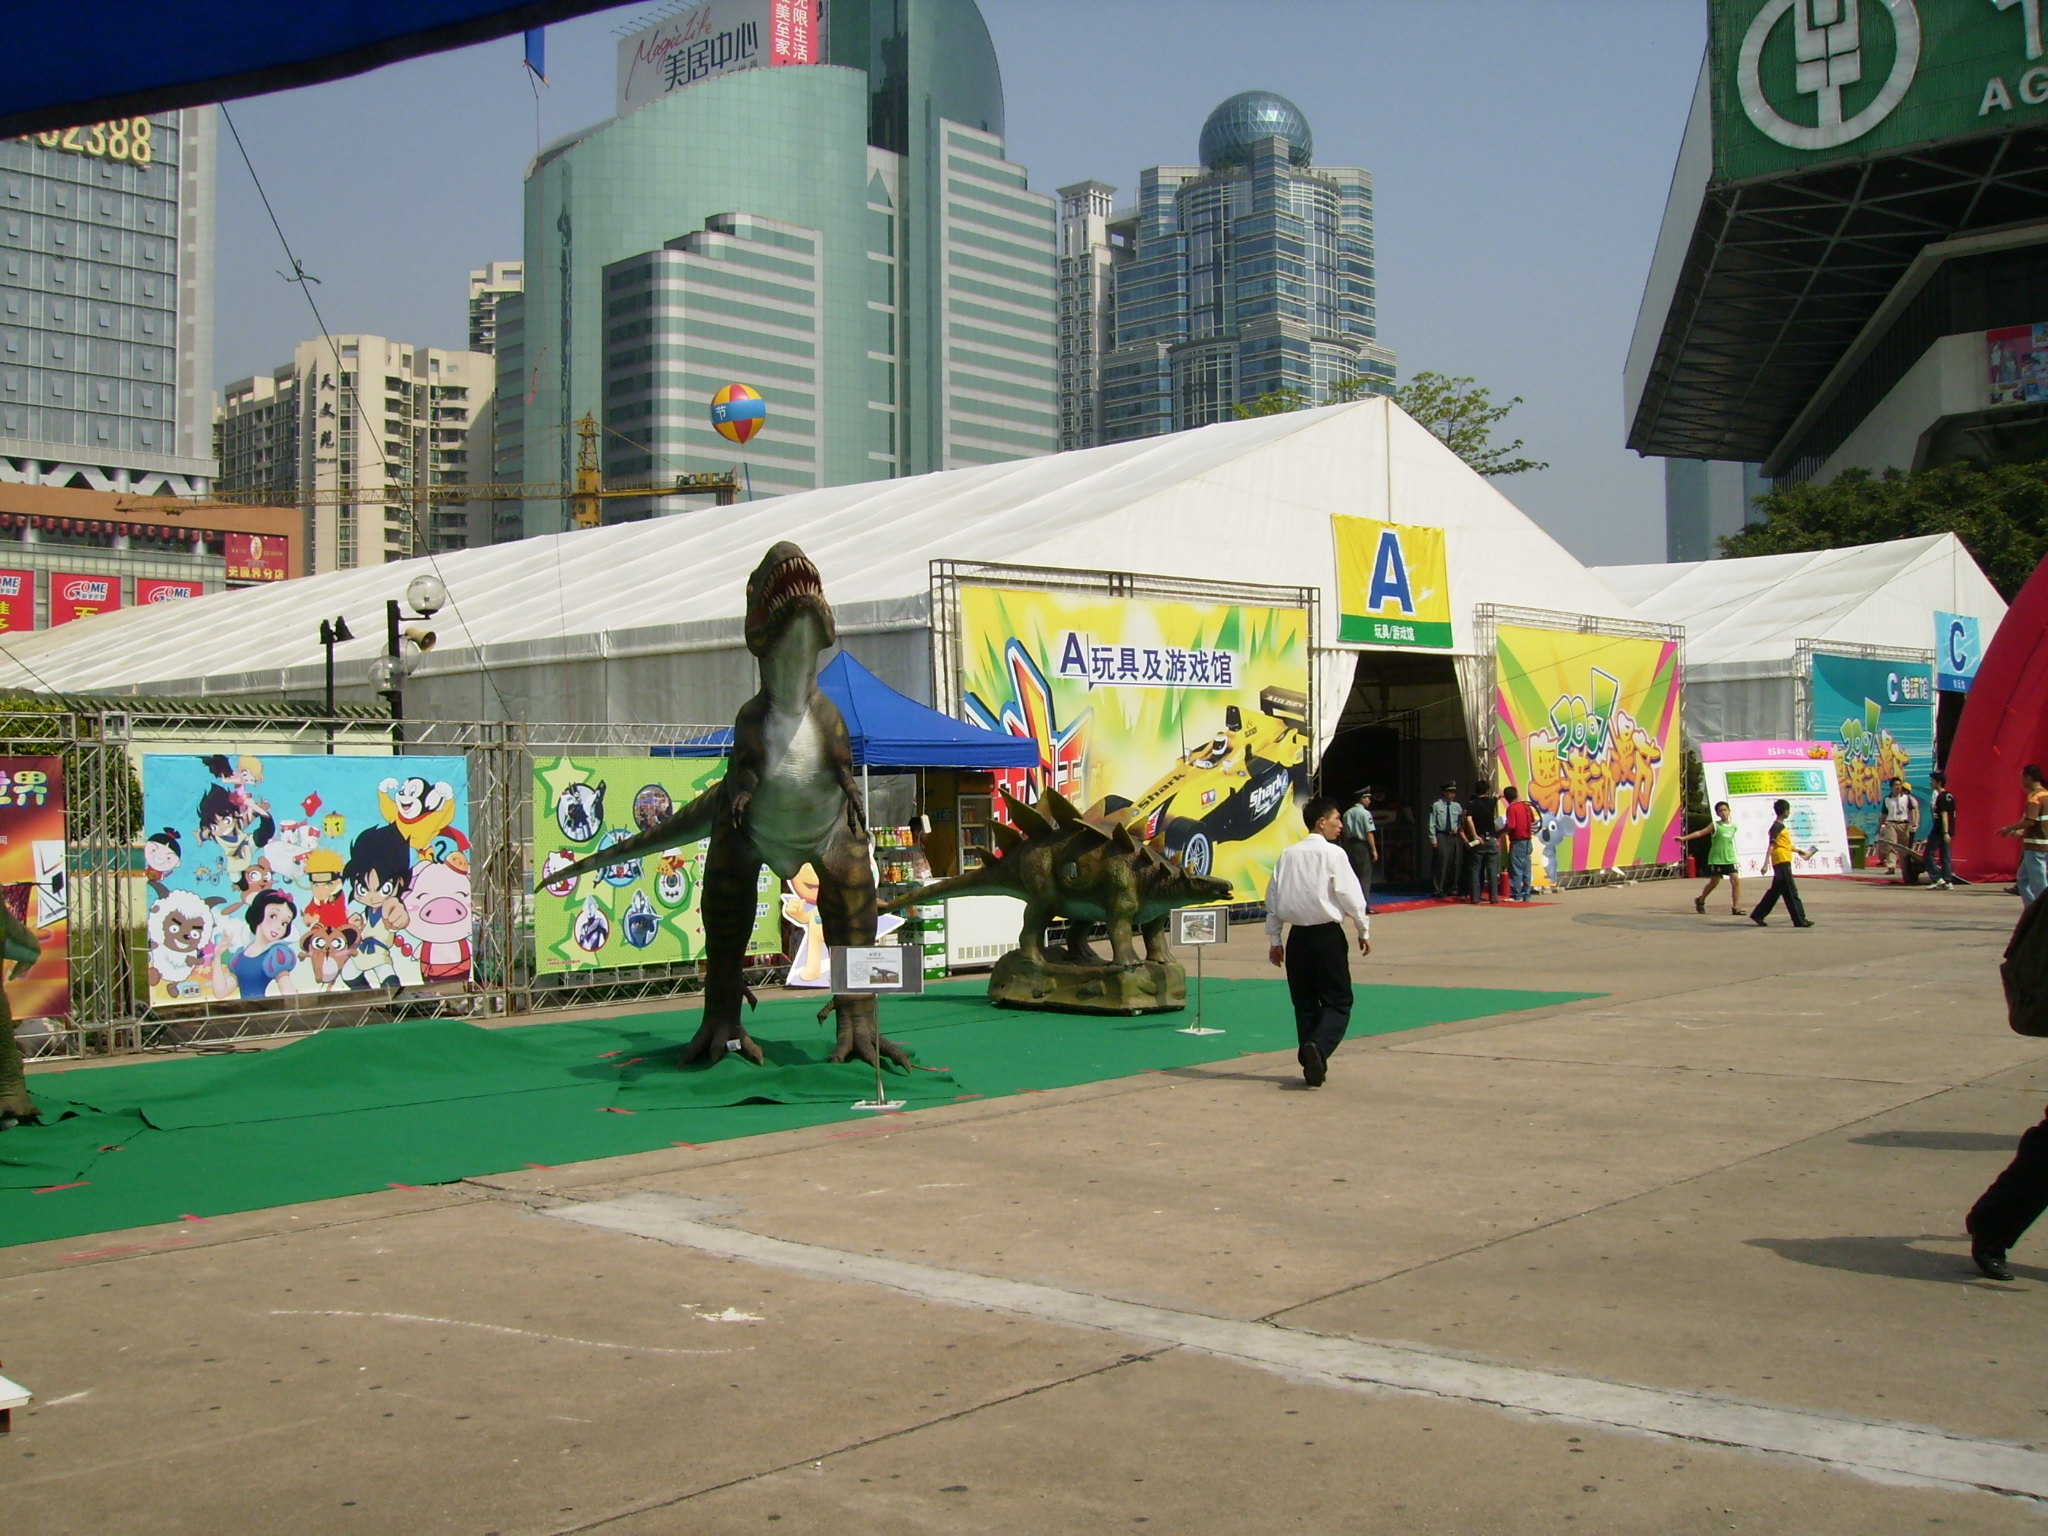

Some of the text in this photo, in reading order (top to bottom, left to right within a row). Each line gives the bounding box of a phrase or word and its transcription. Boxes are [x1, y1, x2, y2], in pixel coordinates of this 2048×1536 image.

[775, 0, 790, 56] 美至家
[664, 21, 759, 93] 美居中心
[20, 116, 151, 164] 2388
[715, 405, 726, 420] 节
[64, 581, 108, 600] GOME
[1367, 530, 1415, 614] A
[1060, 632, 1232, 684] A 玩具及游戏馆
[1949, 619, 1966, 673] C
[1887, 672, 1898, 702] C
[1549, 666, 1619, 762] 2007
[1840, 696, 1882, 766] 2007
[1138, 773, 1186, 809] Shark
[1249, 774, 1282, 808] Shark
